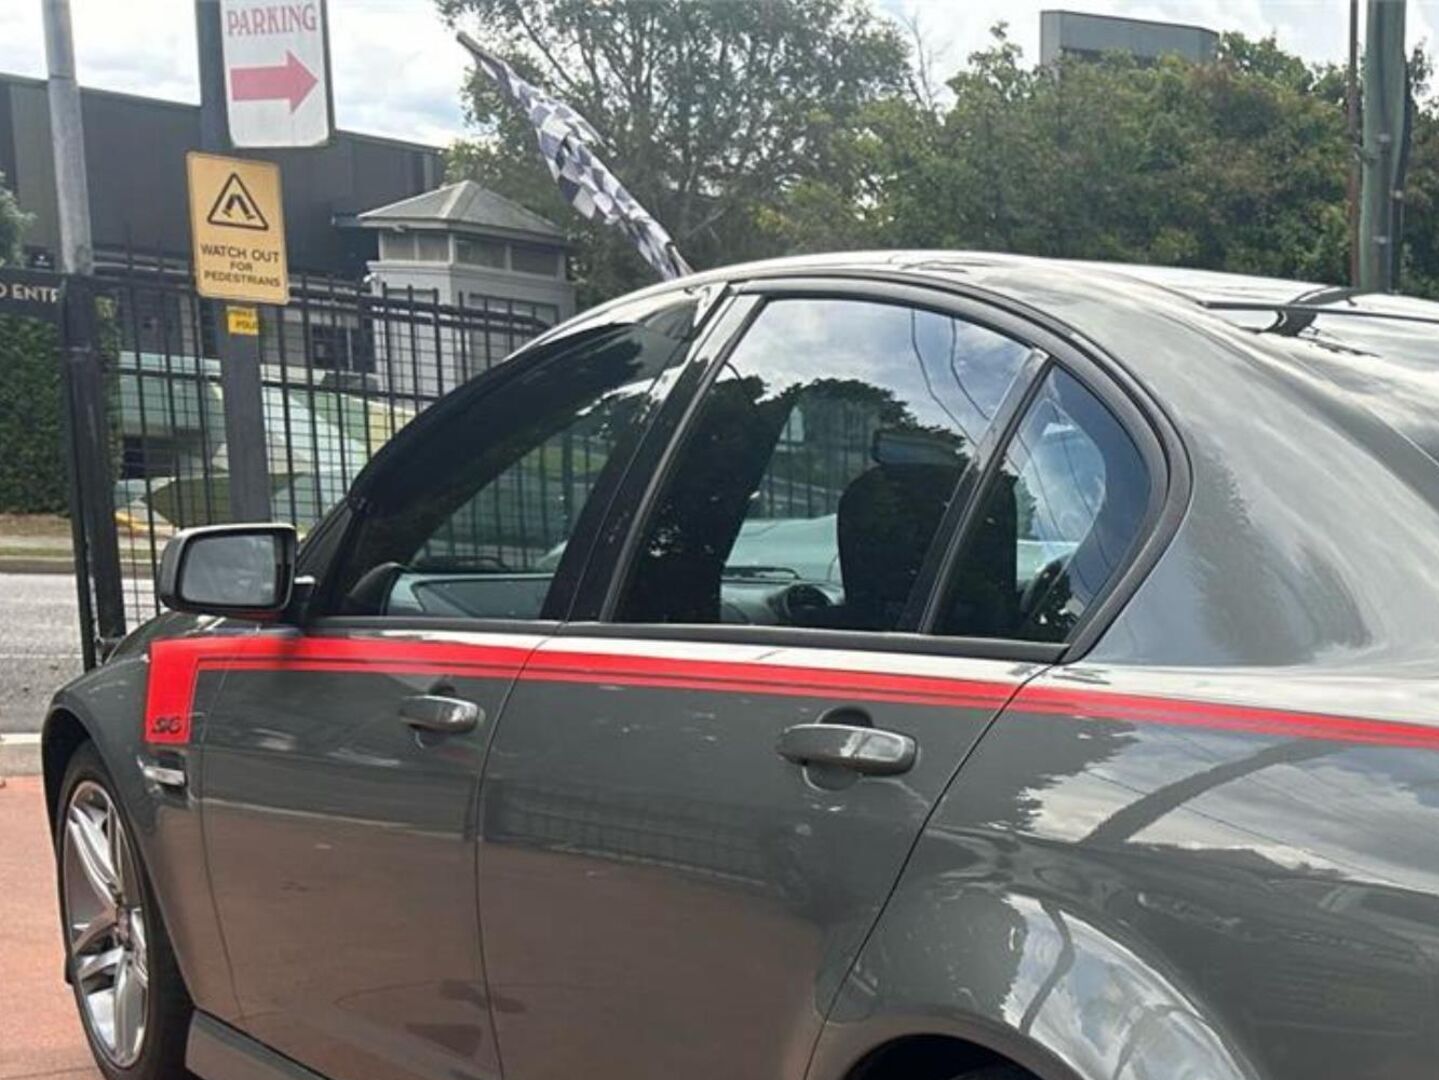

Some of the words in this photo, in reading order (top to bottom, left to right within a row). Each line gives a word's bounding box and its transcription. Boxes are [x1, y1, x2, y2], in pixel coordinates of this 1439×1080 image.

[226, 4, 317, 36] PARKING
[201, 244, 247, 259] WATCH
[252, 249, 279, 262] OUT
[230, 261, 253, 272] FOR
[204, 270, 281, 287] PEDESTRIANS
